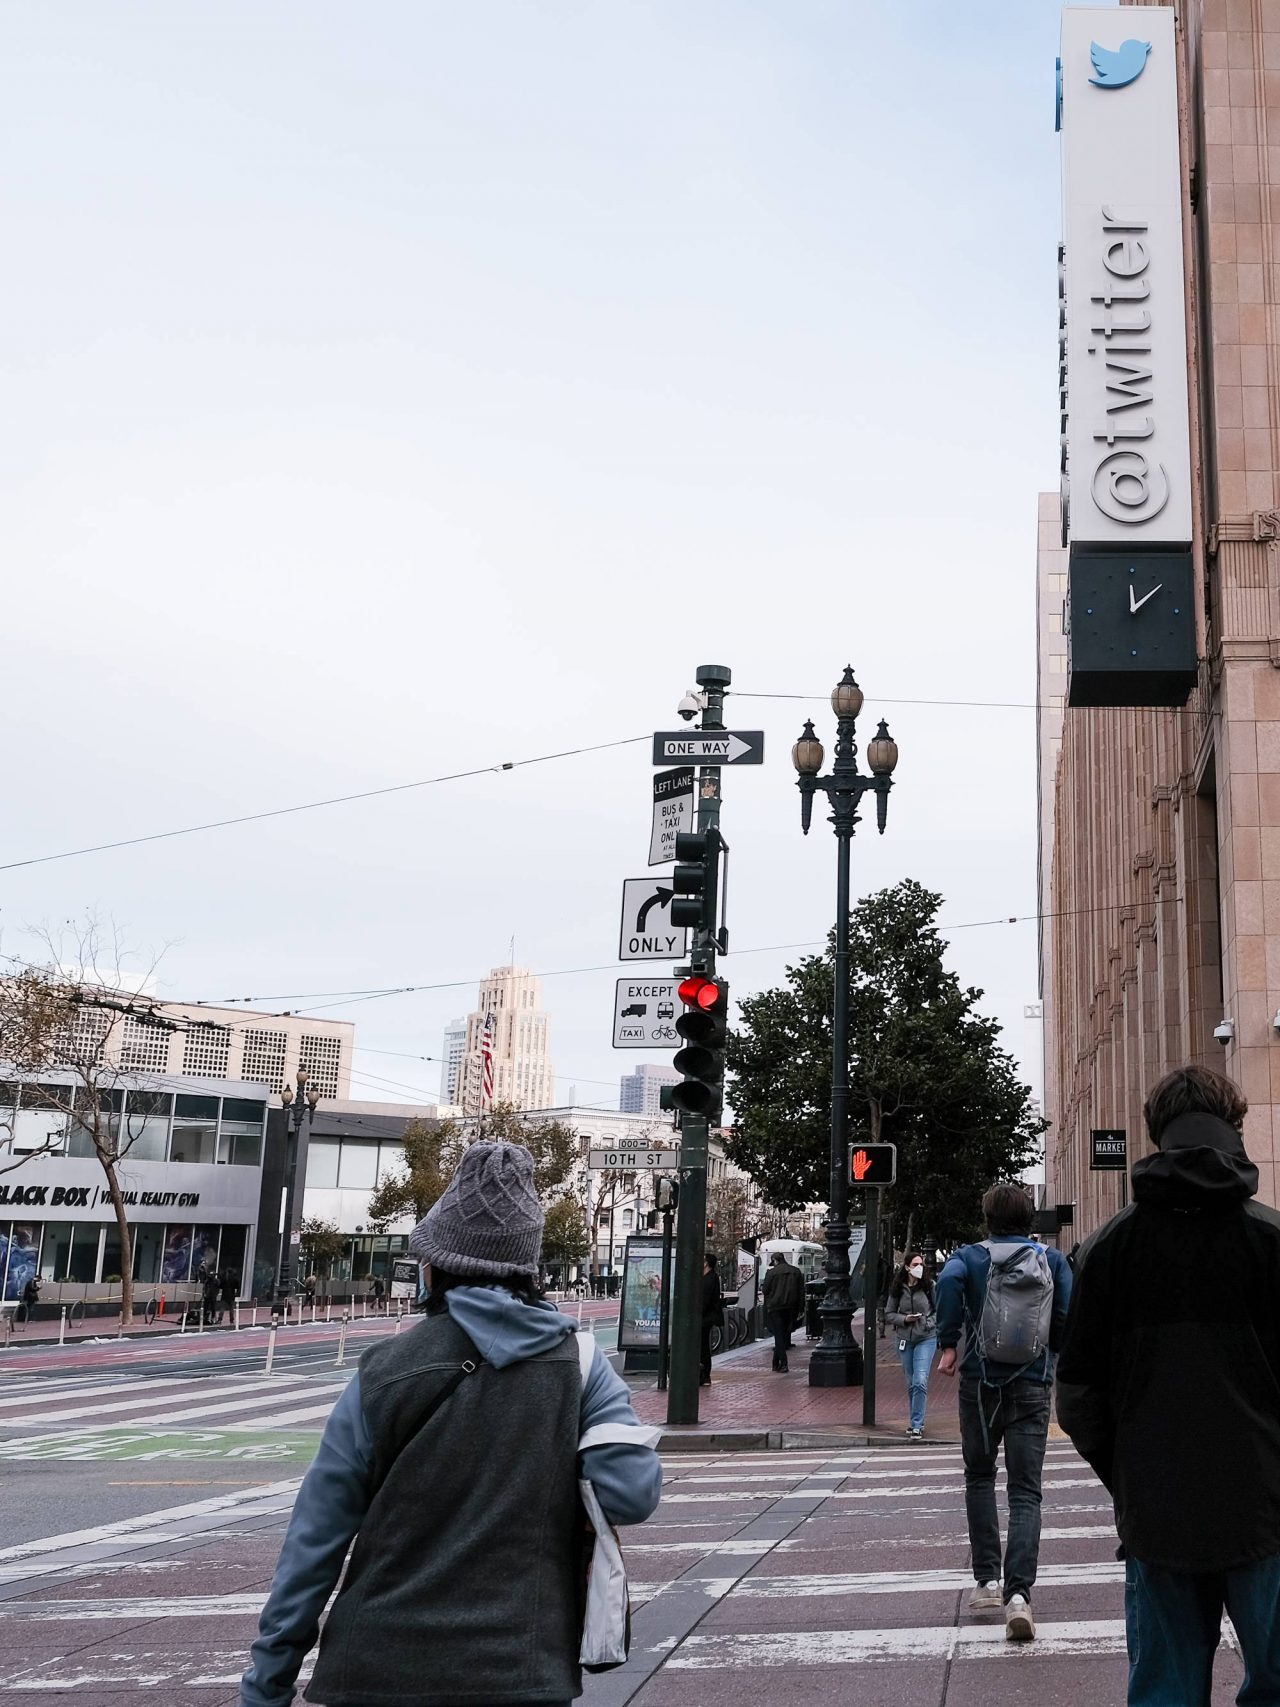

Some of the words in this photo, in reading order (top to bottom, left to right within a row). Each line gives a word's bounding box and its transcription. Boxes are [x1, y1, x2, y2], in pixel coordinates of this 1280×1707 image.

[1087, 204, 1170, 524] @twitter
[667, 742, 695, 754] ONE
[702, 742, 730, 754] WAY
[654, 780, 671, 794] LEFT
[672, 775, 692, 789] LANE
[662, 804, 677, 817] BUS
[678, 802, 684, 812] &
[664, 817, 680, 829] TAXI
[661, 830, 680, 844] ONL
[629, 937, 677, 953] ONLY
[628, 986, 673, 997] EXCEPT
[1096, 1142, 1126, 1153] MARKET
[604, 1154, 636, 1165] 10TH
[647, 1154, 662, 1165] ST
[50, 1187, 91, 1207] BOX
[140, 1191, 179, 1207] REALITY
[178, 1193, 200, 1208] GYM
